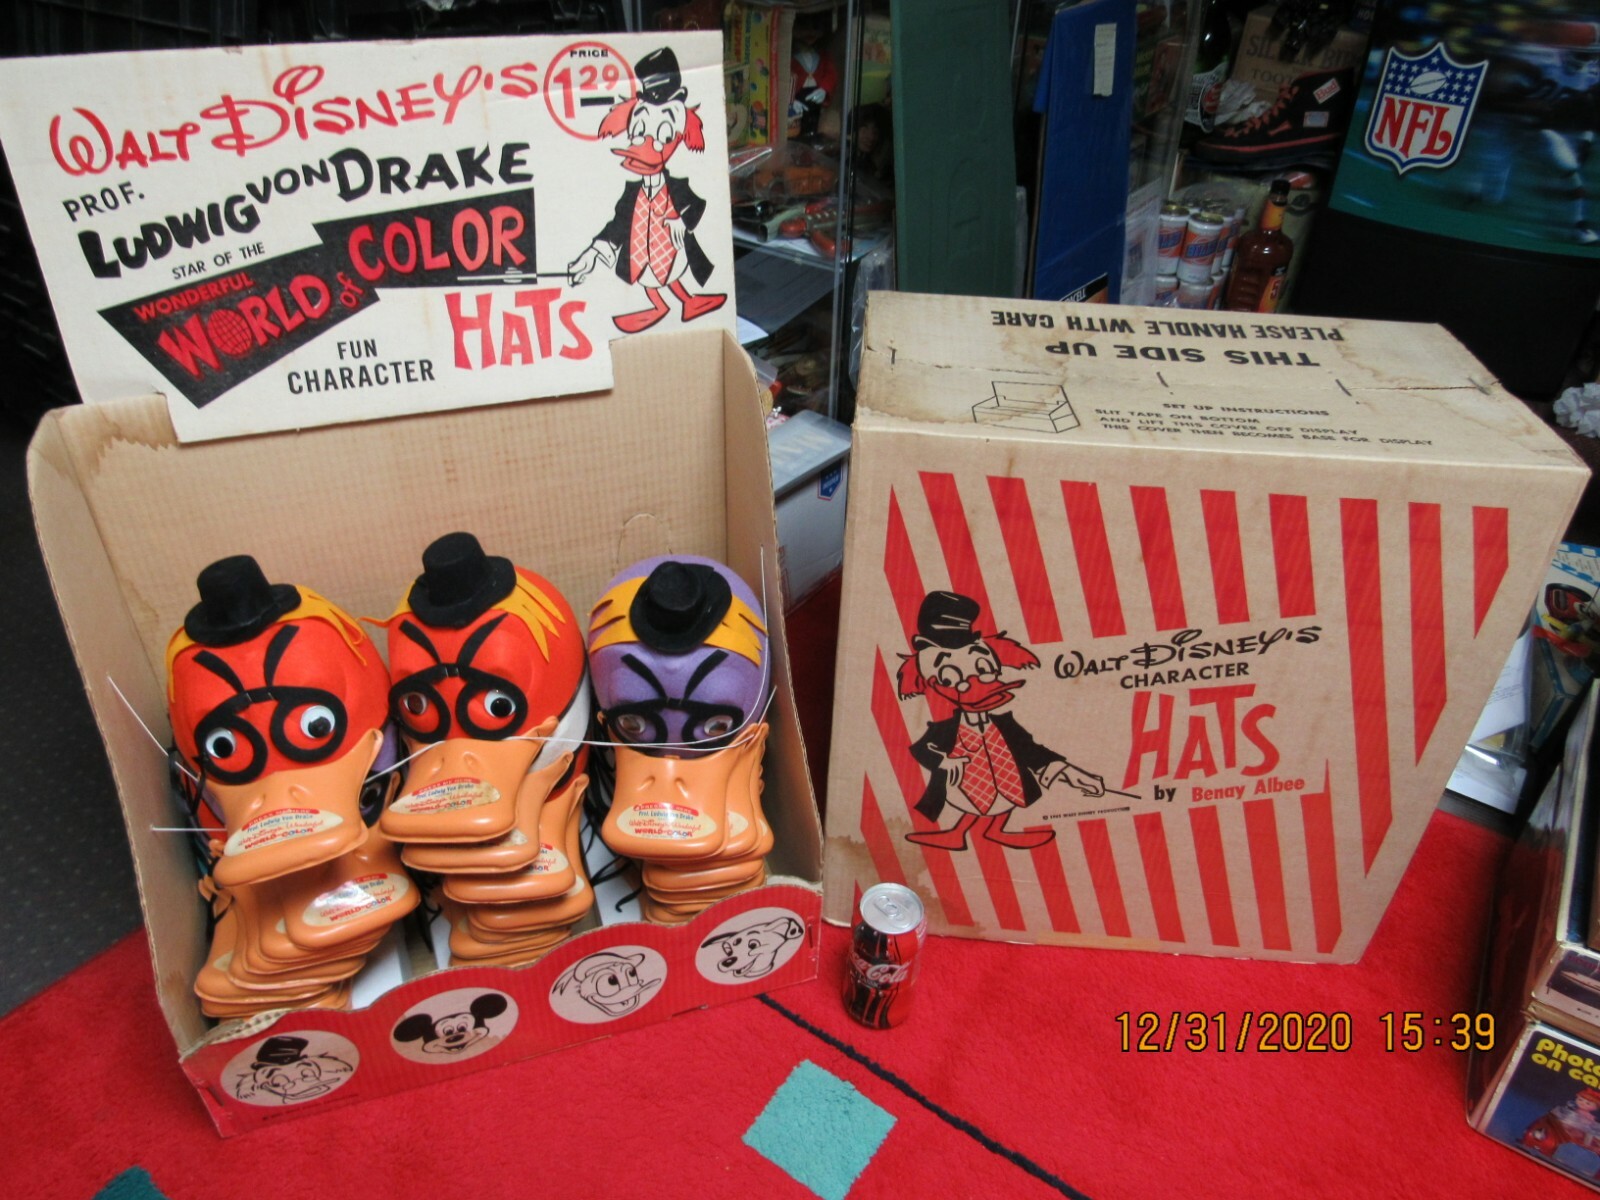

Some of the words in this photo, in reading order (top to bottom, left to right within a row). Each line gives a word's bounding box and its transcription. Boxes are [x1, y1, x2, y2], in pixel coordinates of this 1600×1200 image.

[570, 49, 609, 58] PRICE
[1374, 96, 1452, 159] NFL
[328, 141, 534, 202] DRAKE
[62, 181, 145, 222] PROF.
[348, 205, 527, 281] COLOR
[171, 261, 207, 280] STAR
[213, 251, 233, 267] OF
[239, 242, 266, 259] THE
[134, 271, 256, 322] WONDERFUL
[337, 271, 364, 308] of
[157, 274, 331, 379] WORLD
[444, 287, 593, 370] HATS
[991, 310, 1054, 329] CARE
[1067, 316, 1135, 333] WITH
[1145, 320, 1247, 339] HANDLE
[1251, 324, 1345, 341] PLEASE
[337, 338, 378, 360] FUN
[1044, 341, 1098, 357] UP
[1112, 344, 1206, 362] SIDE
[1223, 350, 1321, 367] THIS
[287, 359, 435, 394] CHARACTER
[1128, 410, 1163, 418] TAPE
[1200, 415, 1261, 424] BOTTOM
[1220, 406, 1330, 416] INSTRUCTIONS
[1100, 416, 1131, 424] AND
[1139, 418, 1165, 426] LIFT
[1173, 420, 1203, 428] THIS
[1210, 423, 1258, 431] COVER
[1300, 427, 1358, 436] DISPLAY
[1101, 423, 1129, 431] THIS
[1137, 425, 1182, 433] COVER
[1188, 428, 1224, 436] THEN
[1231, 431, 1294, 440] BECOMES
[1379, 438, 1433, 446] DISPLAY
[1120, 661, 1250, 690] CHARACTER
[1121, 683, 1280, 790] HATS
[1154, 784, 1177, 803] by
[1191, 783, 1246, 803] Benay
[1253, 776, 1305, 796] Albee
[443, 799, 473, 809] COLOR
[281, 827, 314, 838] COLOR
[329, 906, 363, 922] WORLD
[365, 895, 392, 909] COLOR
[1531, 1052, 1562, 1072] on
[1568, 1068, 1600, 1090] ca
